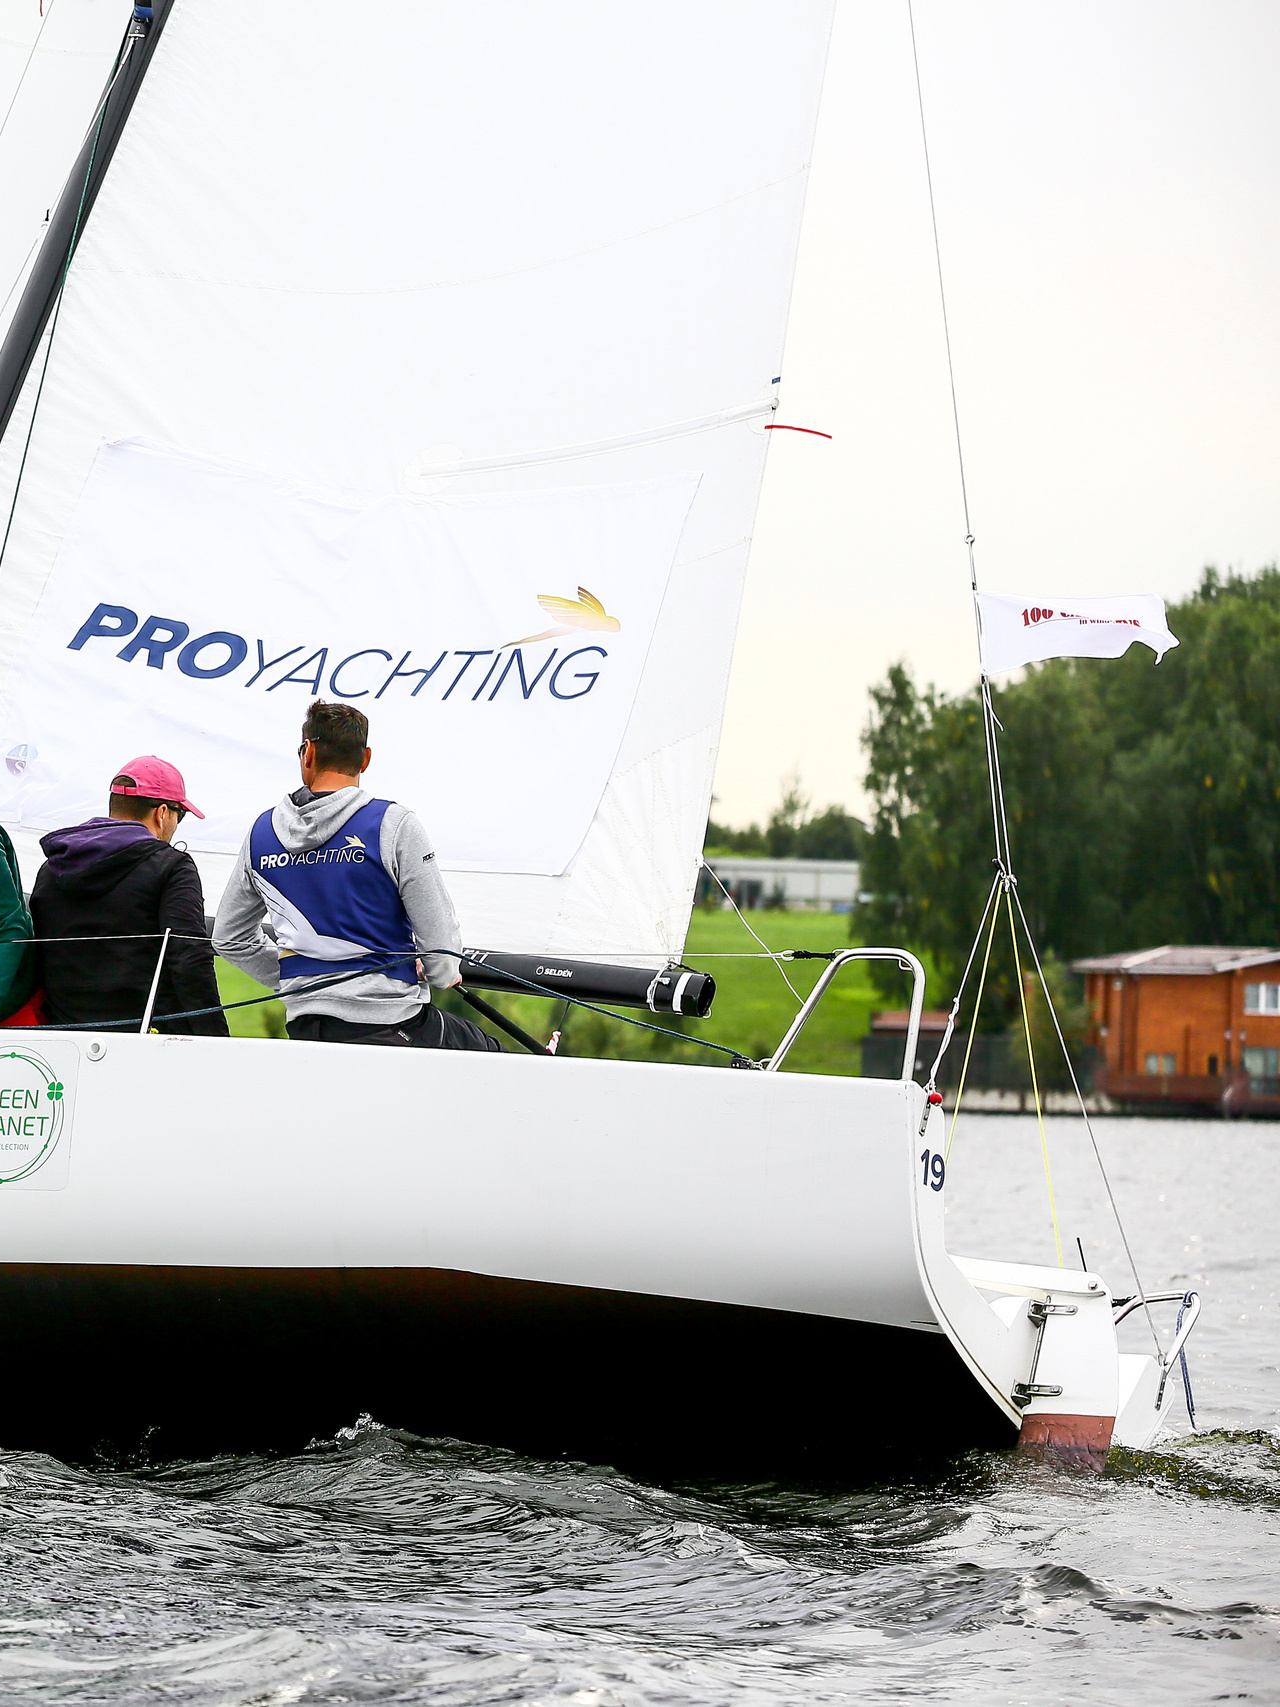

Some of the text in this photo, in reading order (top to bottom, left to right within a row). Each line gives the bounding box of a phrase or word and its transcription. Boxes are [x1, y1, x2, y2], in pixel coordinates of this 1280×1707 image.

[66, 602, 608, 702] PROYACHTING
[260, 848, 365, 870] PROYACHTING
[920, 1148, 946, 1193] 19
